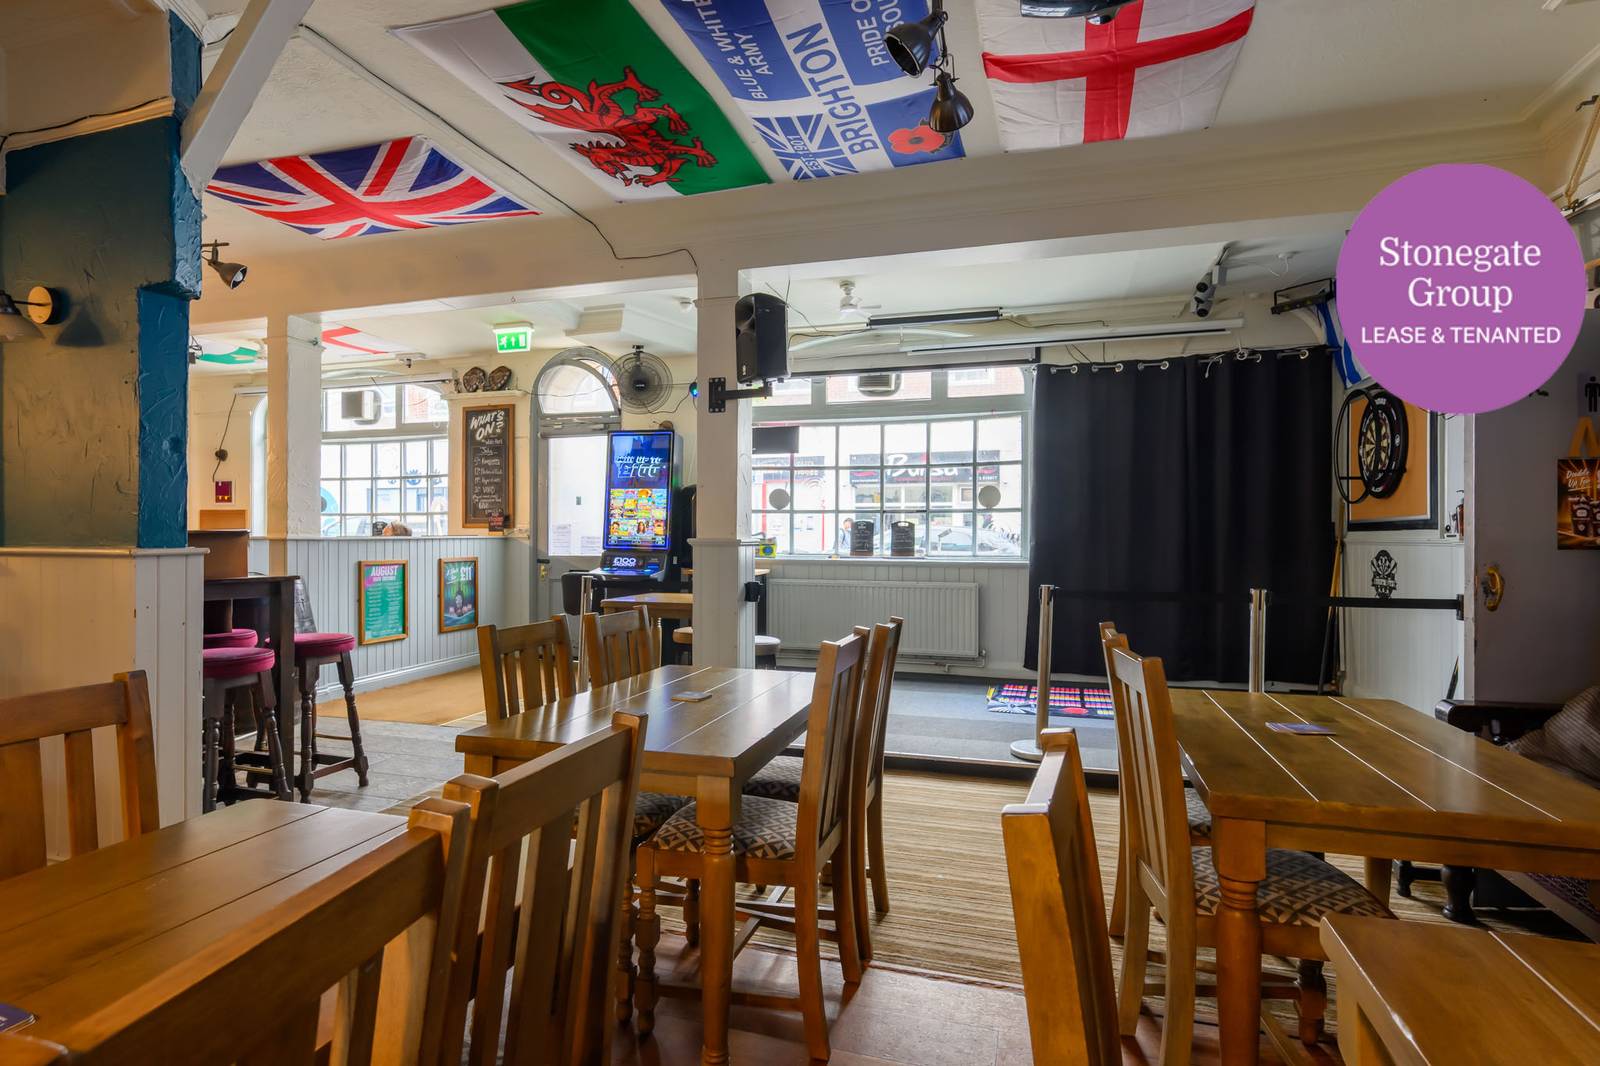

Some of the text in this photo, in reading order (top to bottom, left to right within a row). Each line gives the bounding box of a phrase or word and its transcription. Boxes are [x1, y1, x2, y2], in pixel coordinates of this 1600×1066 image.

[694, 0, 768, 99] BLUE & WHITE
[733, 32, 774, 75] ARMY
[856, 16, 890, 66] PRIDE
[785, 22, 880, 155] BRIGHTON
[470, 410, 505, 430] WHAT'S
[370, 565, 399, 577] AUGUST
